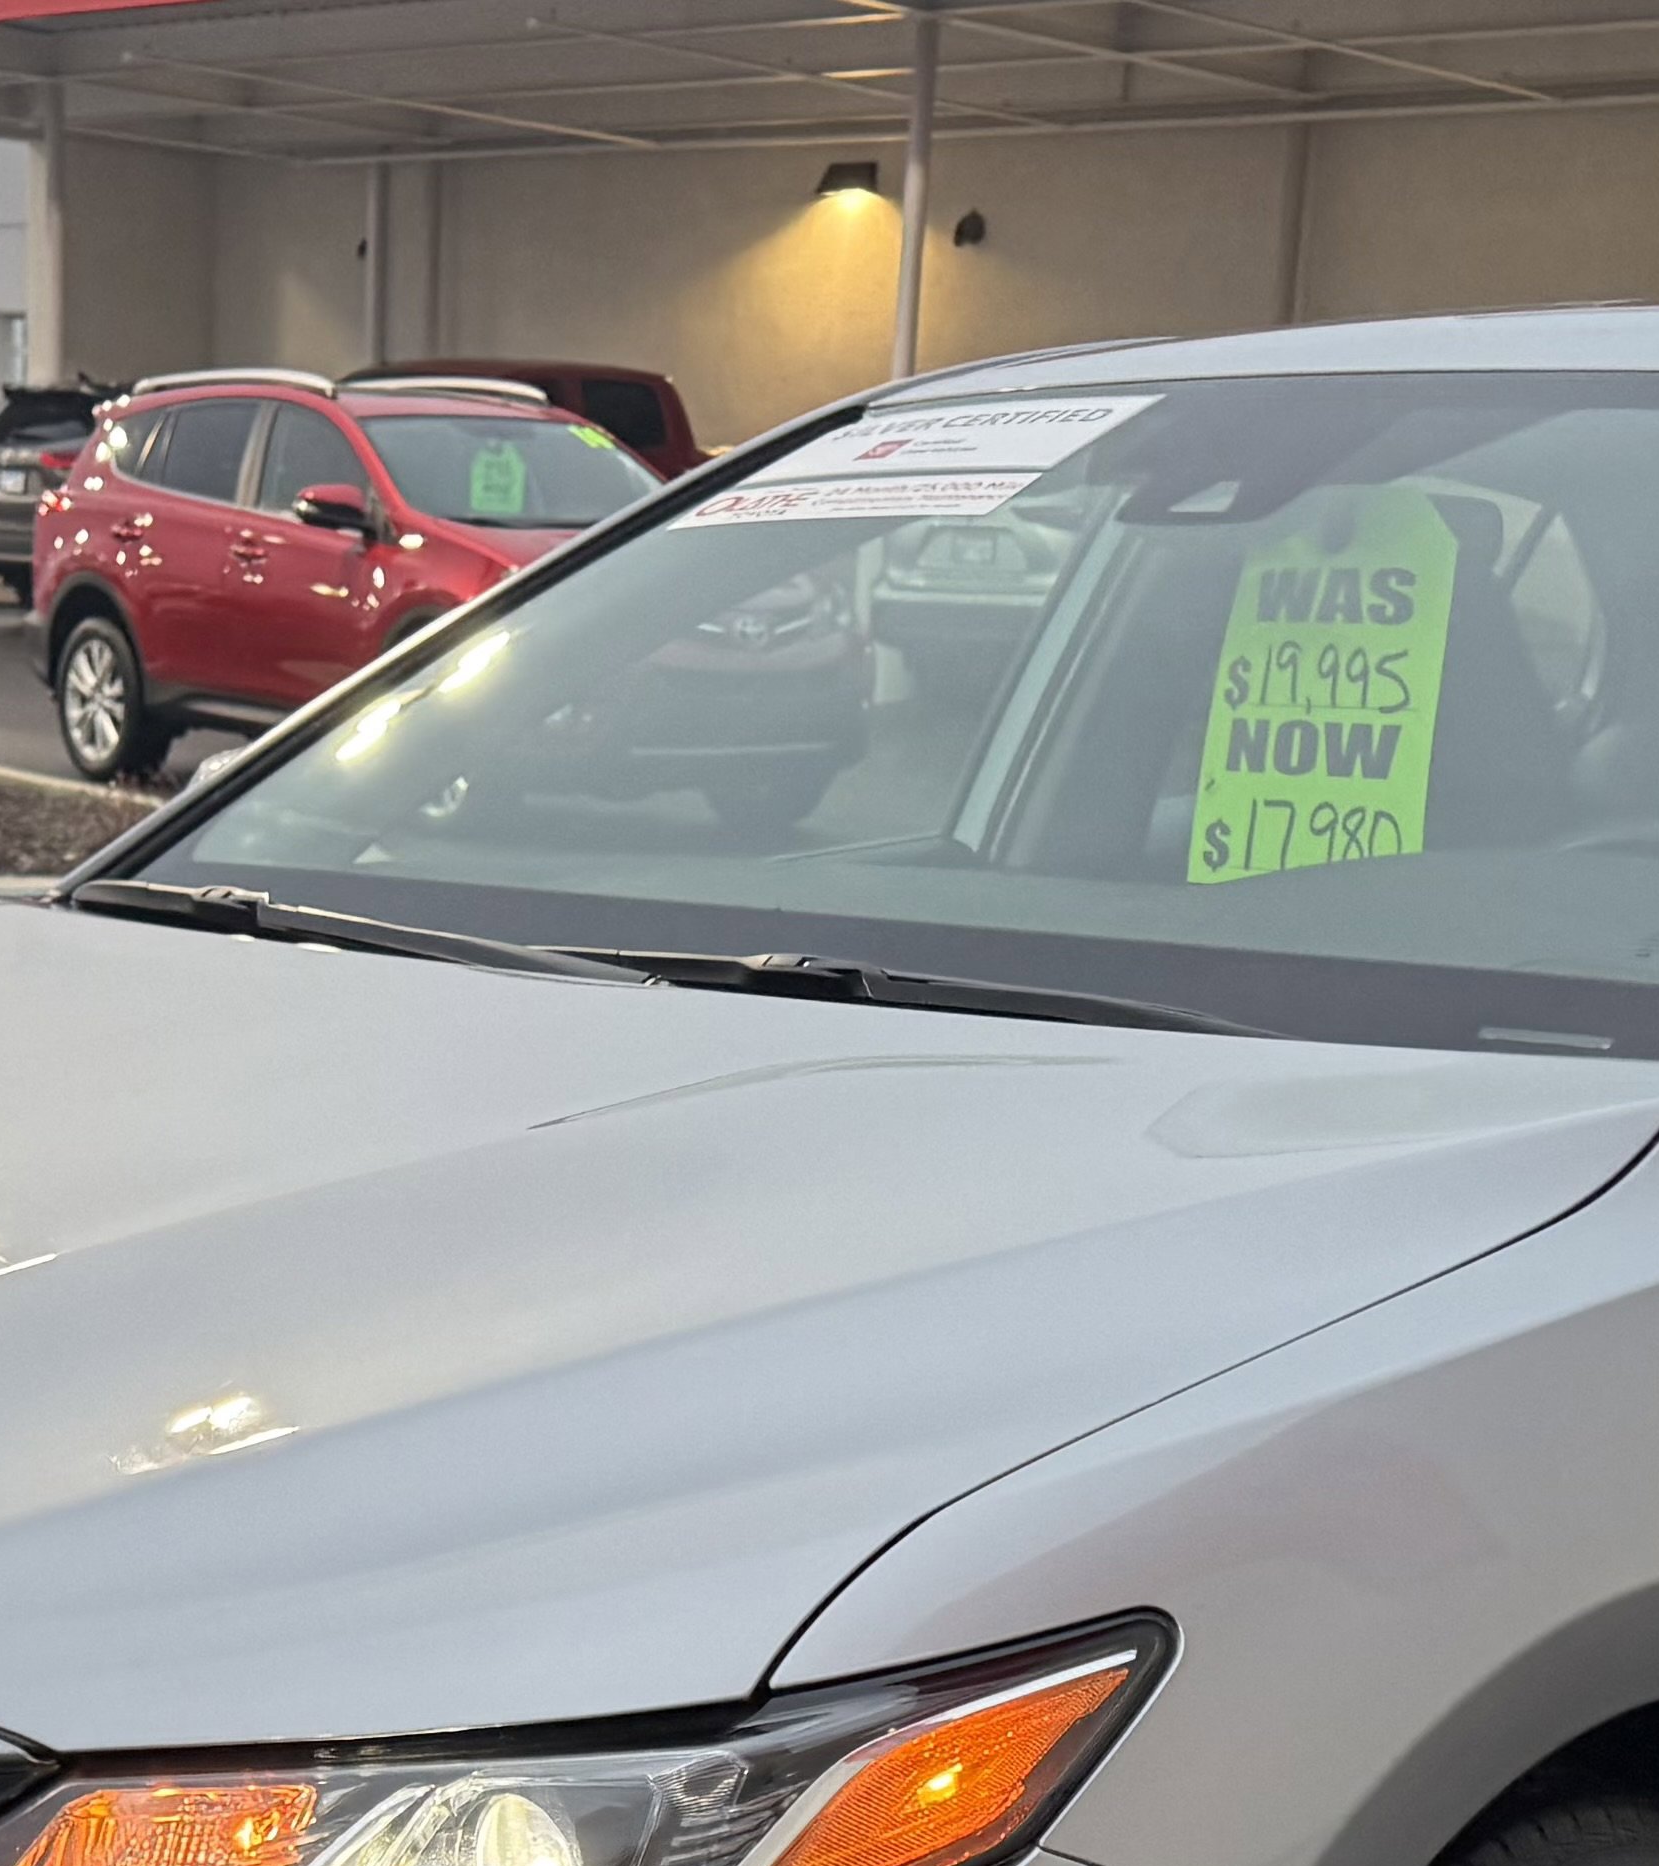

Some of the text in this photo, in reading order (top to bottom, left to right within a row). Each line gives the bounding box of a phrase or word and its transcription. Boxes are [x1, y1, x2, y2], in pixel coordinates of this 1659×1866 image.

[942, 409, 1113, 428] CERTIFIED
[694, 493, 815, 516] OLATHE
[1256, 567, 1417, 625] WAS
[1223, 640, 1412, 715] $19,995
[1225, 718, 1402, 781] NOW
